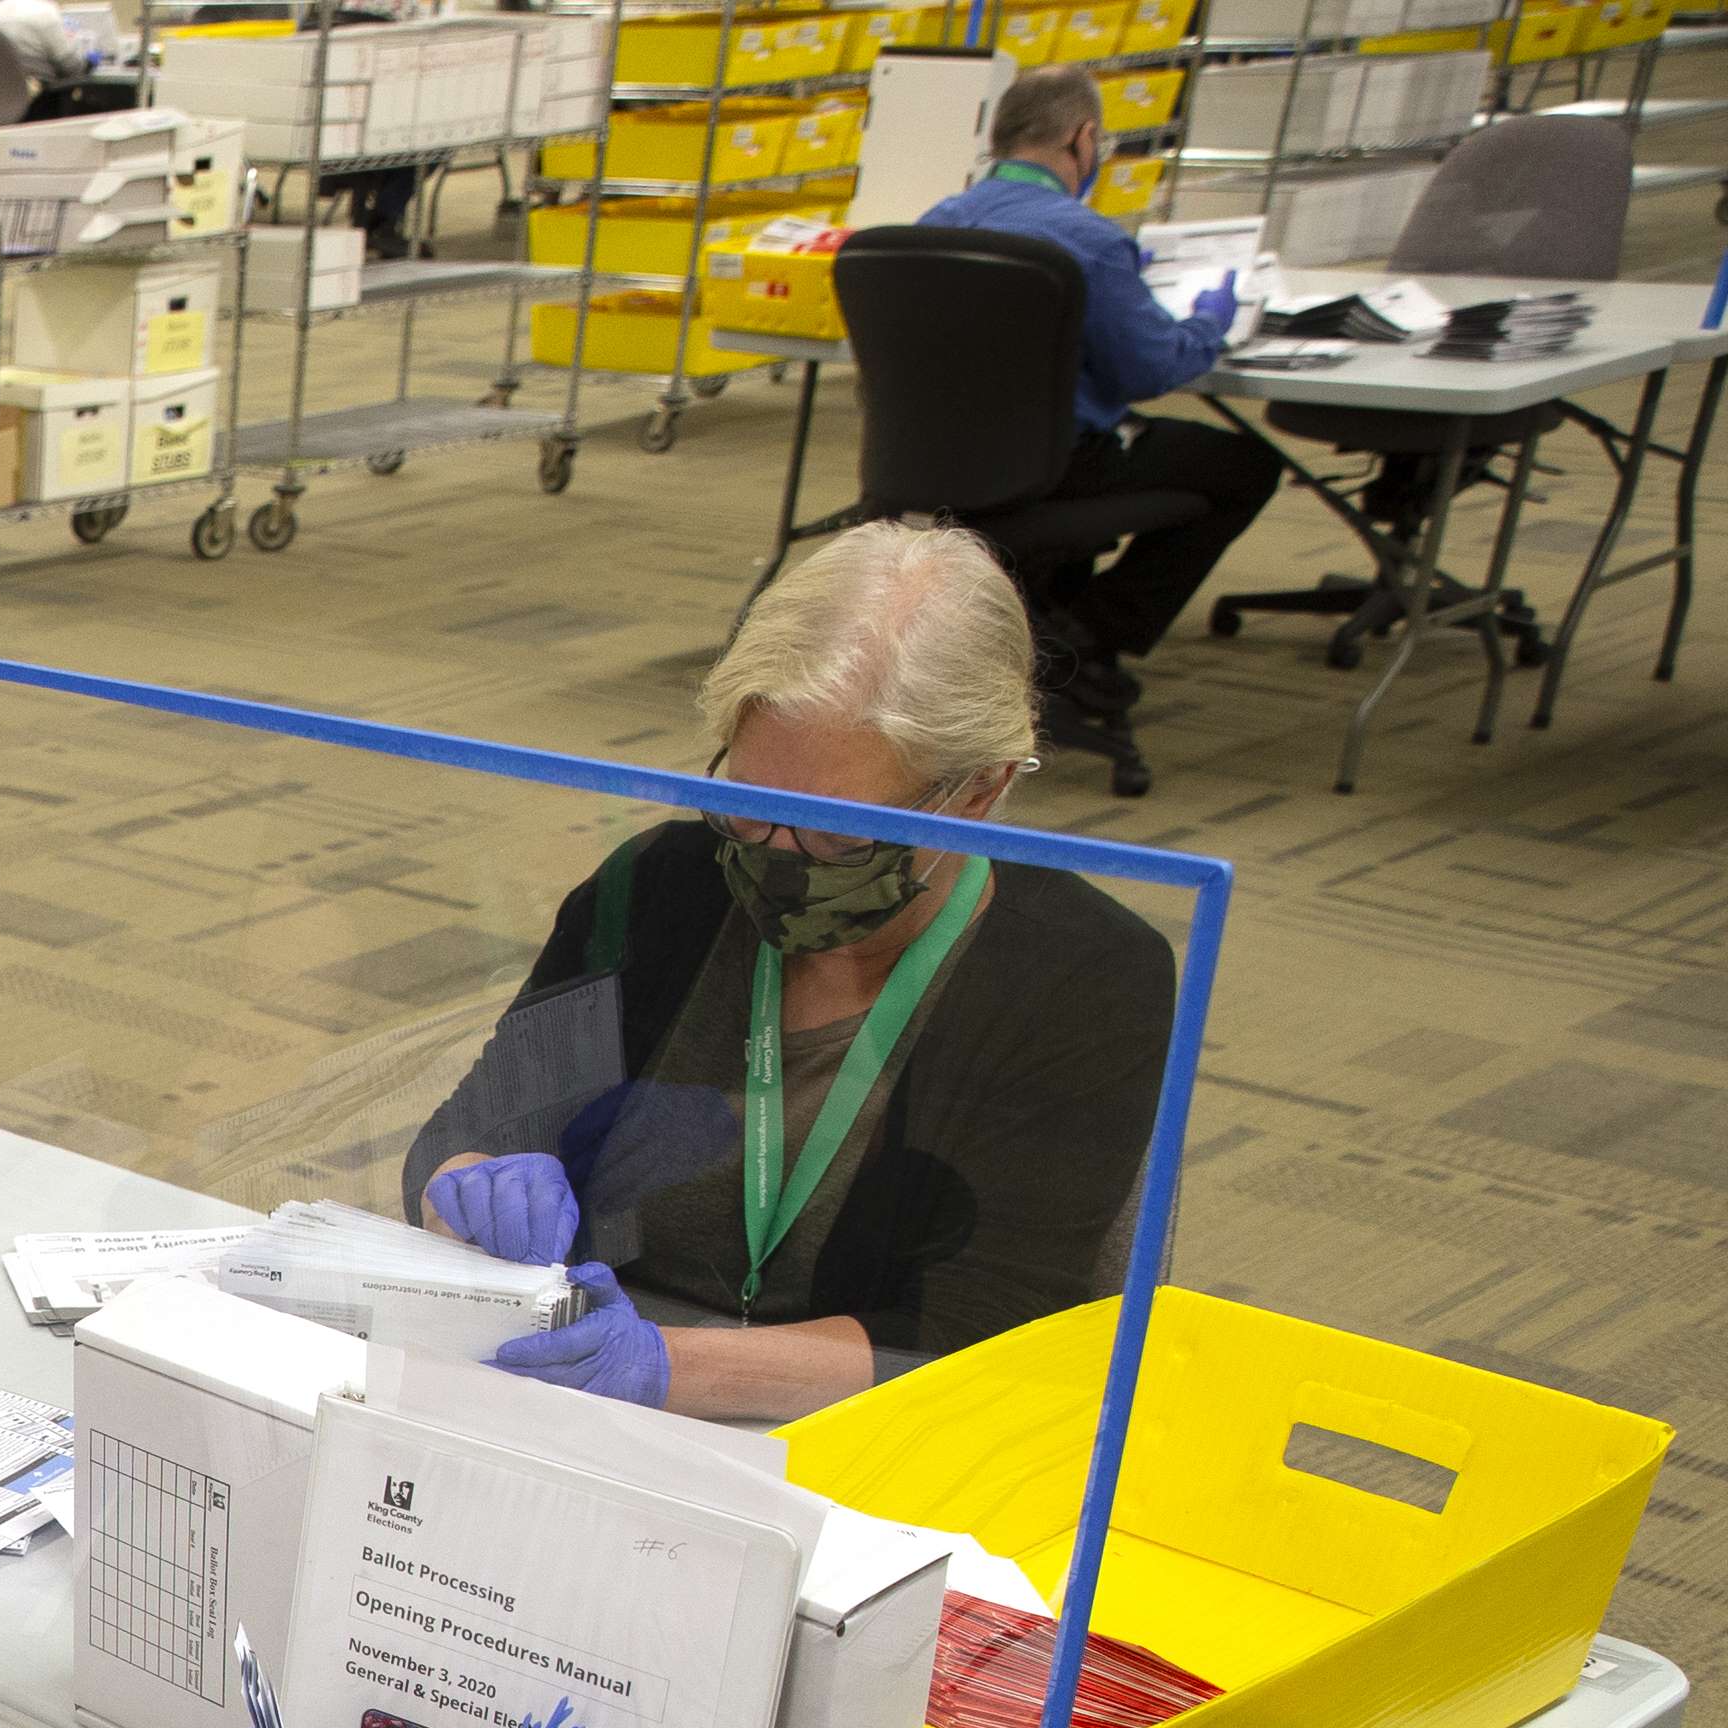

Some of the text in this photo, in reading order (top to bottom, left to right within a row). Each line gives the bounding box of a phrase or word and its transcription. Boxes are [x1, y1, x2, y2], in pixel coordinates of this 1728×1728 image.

[96, 1242, 147, 1255] sleeve
[153, 1234, 216, 1250] security
[361, 1282, 511, 1305] See other side for instructions
[366, 1500, 424, 1527] King County
[366, 1513, 414, 1535] Elections
[205, 1545, 218, 1640] Ballot Box Seal Log
[360, 1545, 517, 1613] Ballot Processing
[353, 1589, 632, 1697] Opening Procedures Manual
[346, 1636, 498, 1700] November 3, 2020
[344, 1659, 409, 1694] General
[412, 1682, 426, 1700] &
[427, 1688, 489, 1725] Special
